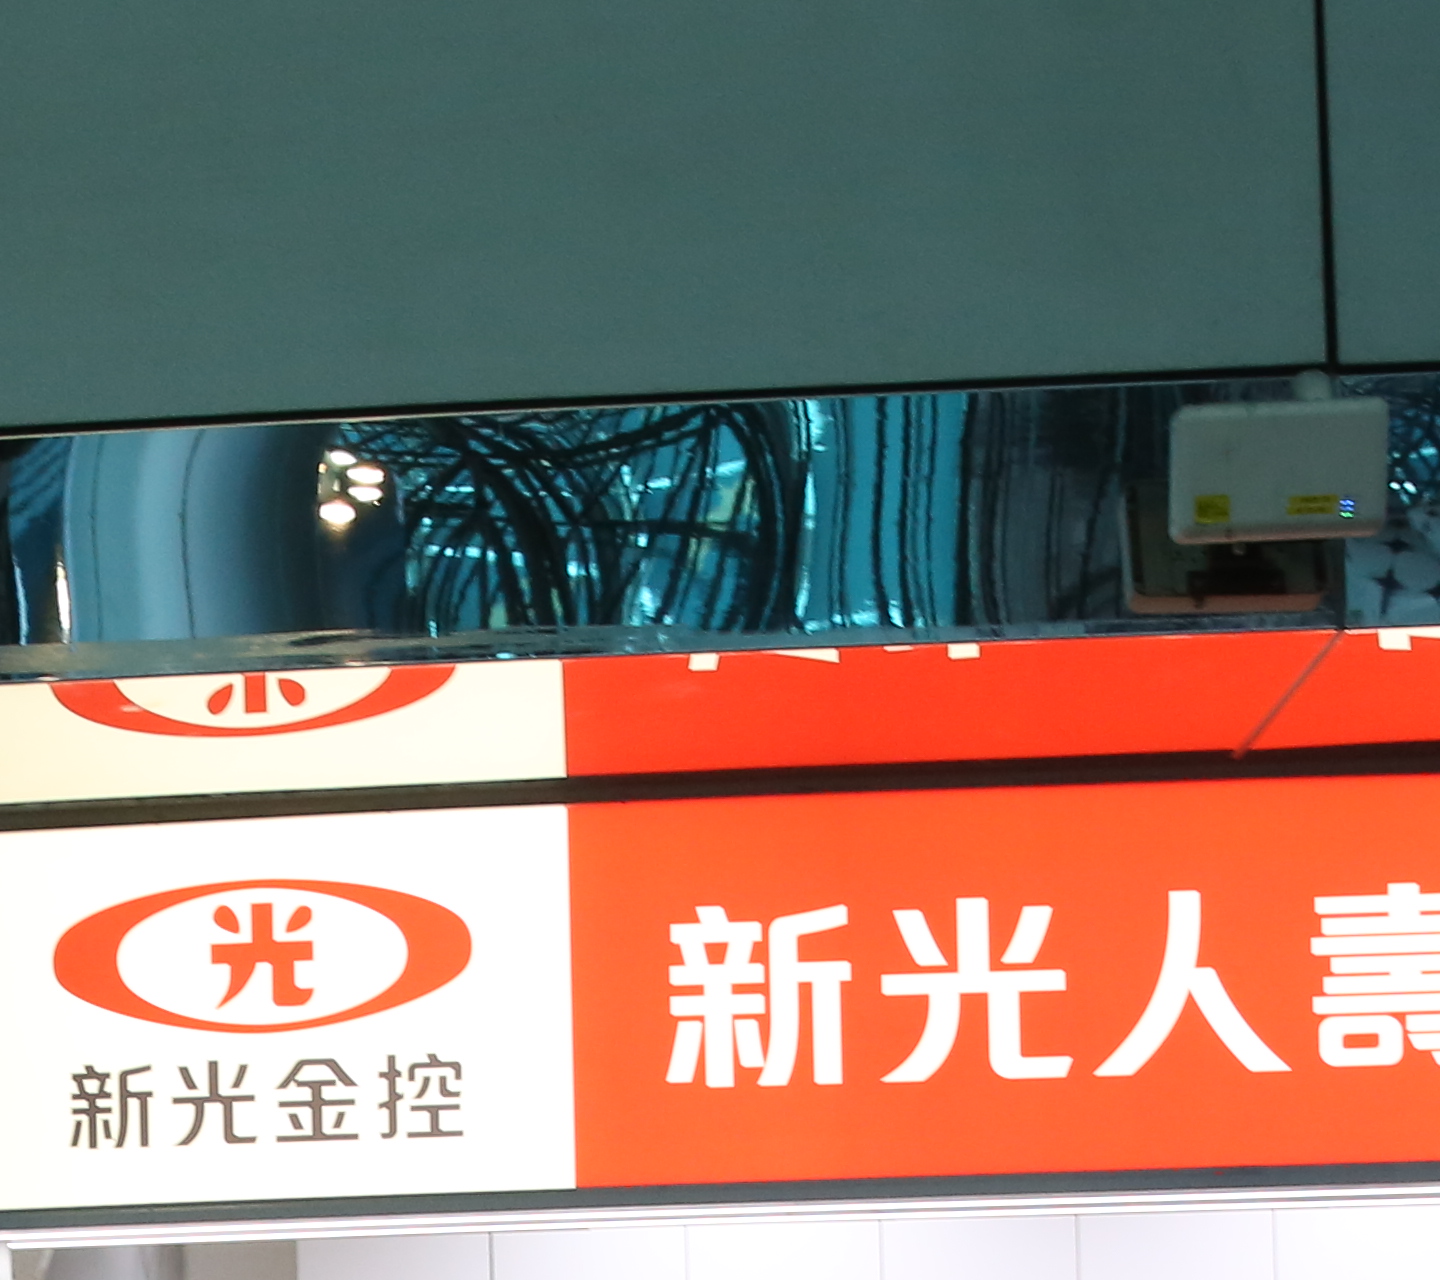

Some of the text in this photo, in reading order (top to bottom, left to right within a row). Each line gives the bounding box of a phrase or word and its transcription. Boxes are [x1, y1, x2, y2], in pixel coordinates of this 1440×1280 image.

[210, 901, 315, 1010] 光
[69, 1053, 465, 1149] 新光金控
